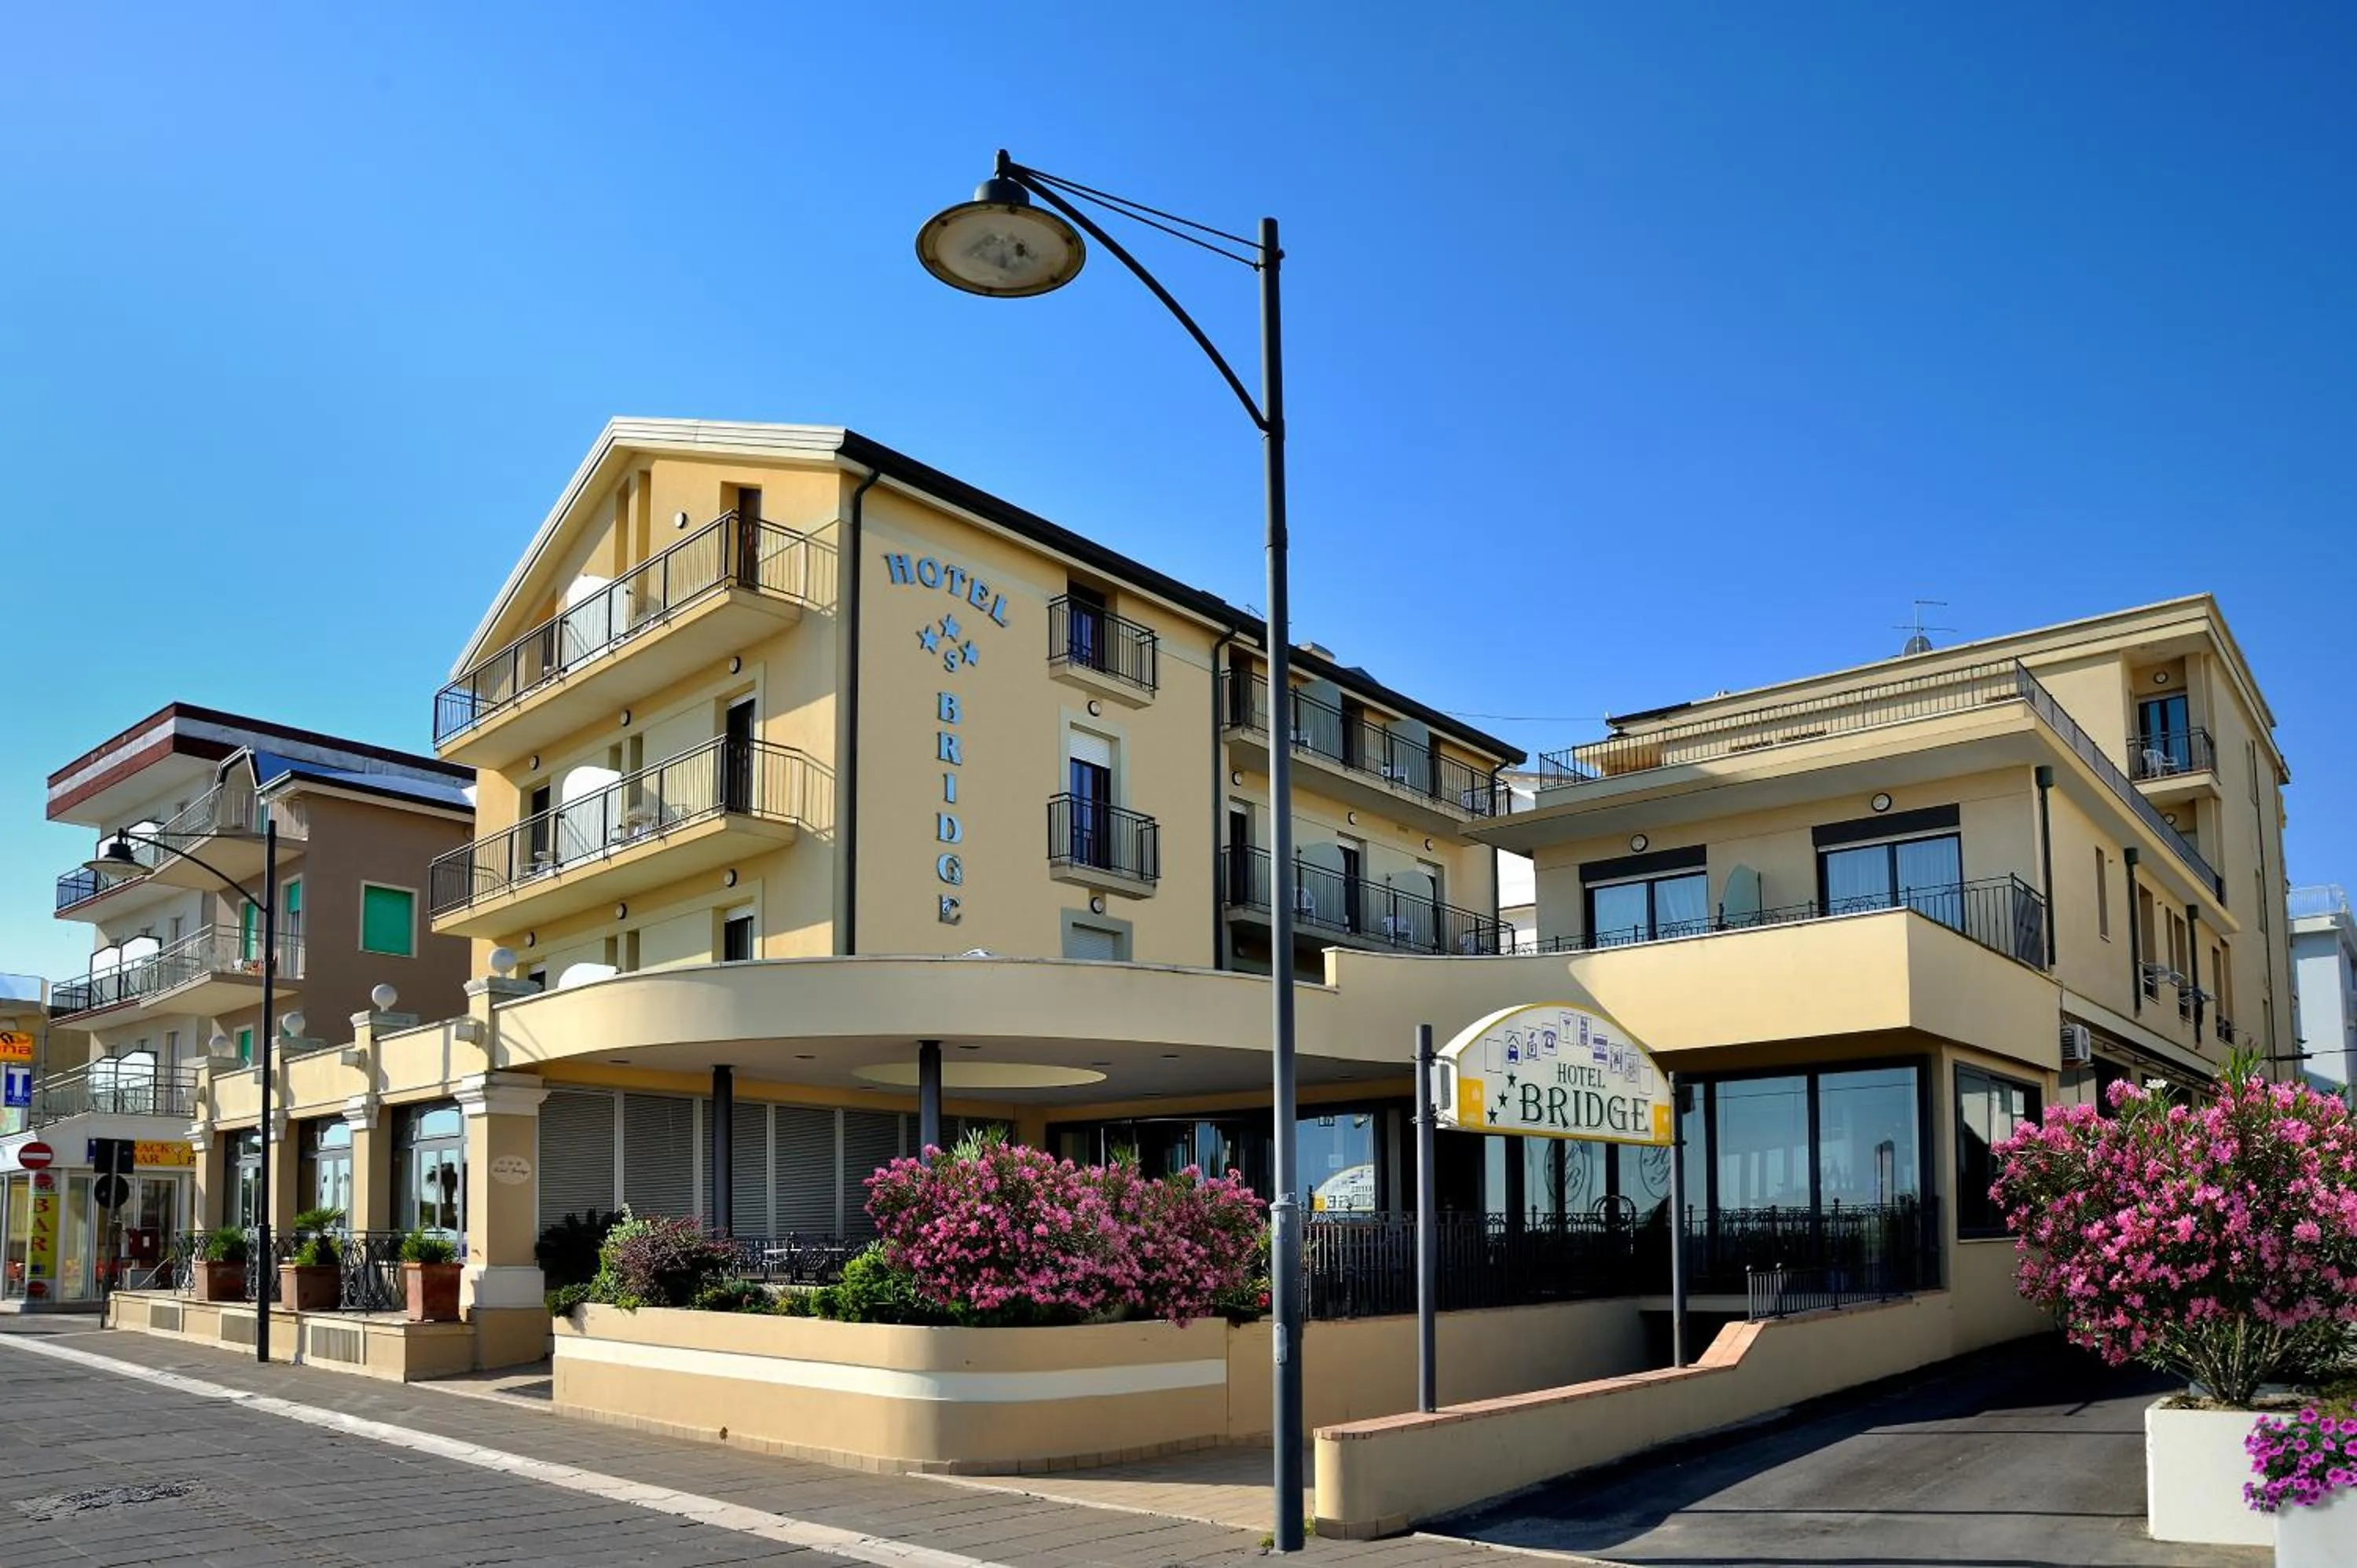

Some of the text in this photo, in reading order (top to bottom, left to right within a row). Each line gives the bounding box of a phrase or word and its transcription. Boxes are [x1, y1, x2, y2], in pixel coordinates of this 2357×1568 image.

[883, 553, 1010, 628] HOTEL
[937, 692, 963, 925] BRIDGE
[1558, 1063, 1606, 1088] HOTEL
[1519, 1083, 1648, 1132] BRIDGE
[31, 1198, 49, 1251] BAR
